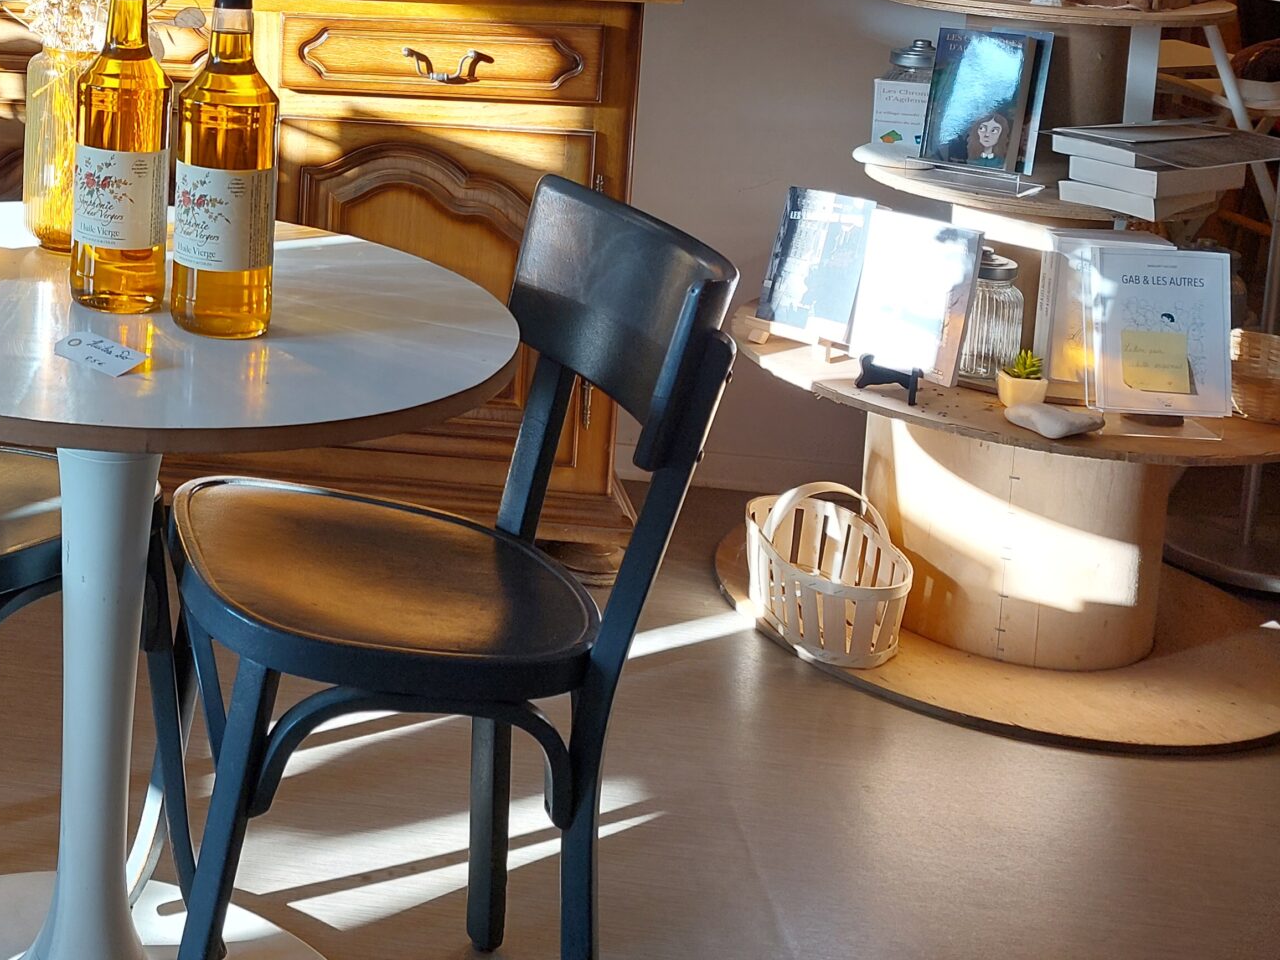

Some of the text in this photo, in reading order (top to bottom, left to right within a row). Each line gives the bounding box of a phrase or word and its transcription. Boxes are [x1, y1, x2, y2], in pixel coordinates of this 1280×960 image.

[882, 87, 897, 95] Les
[80, 221, 120, 238] Huile Vierge
[192, 246, 216, 259] Vierge
[1121, 274, 1205, 288] GAB & LES AUTRES
